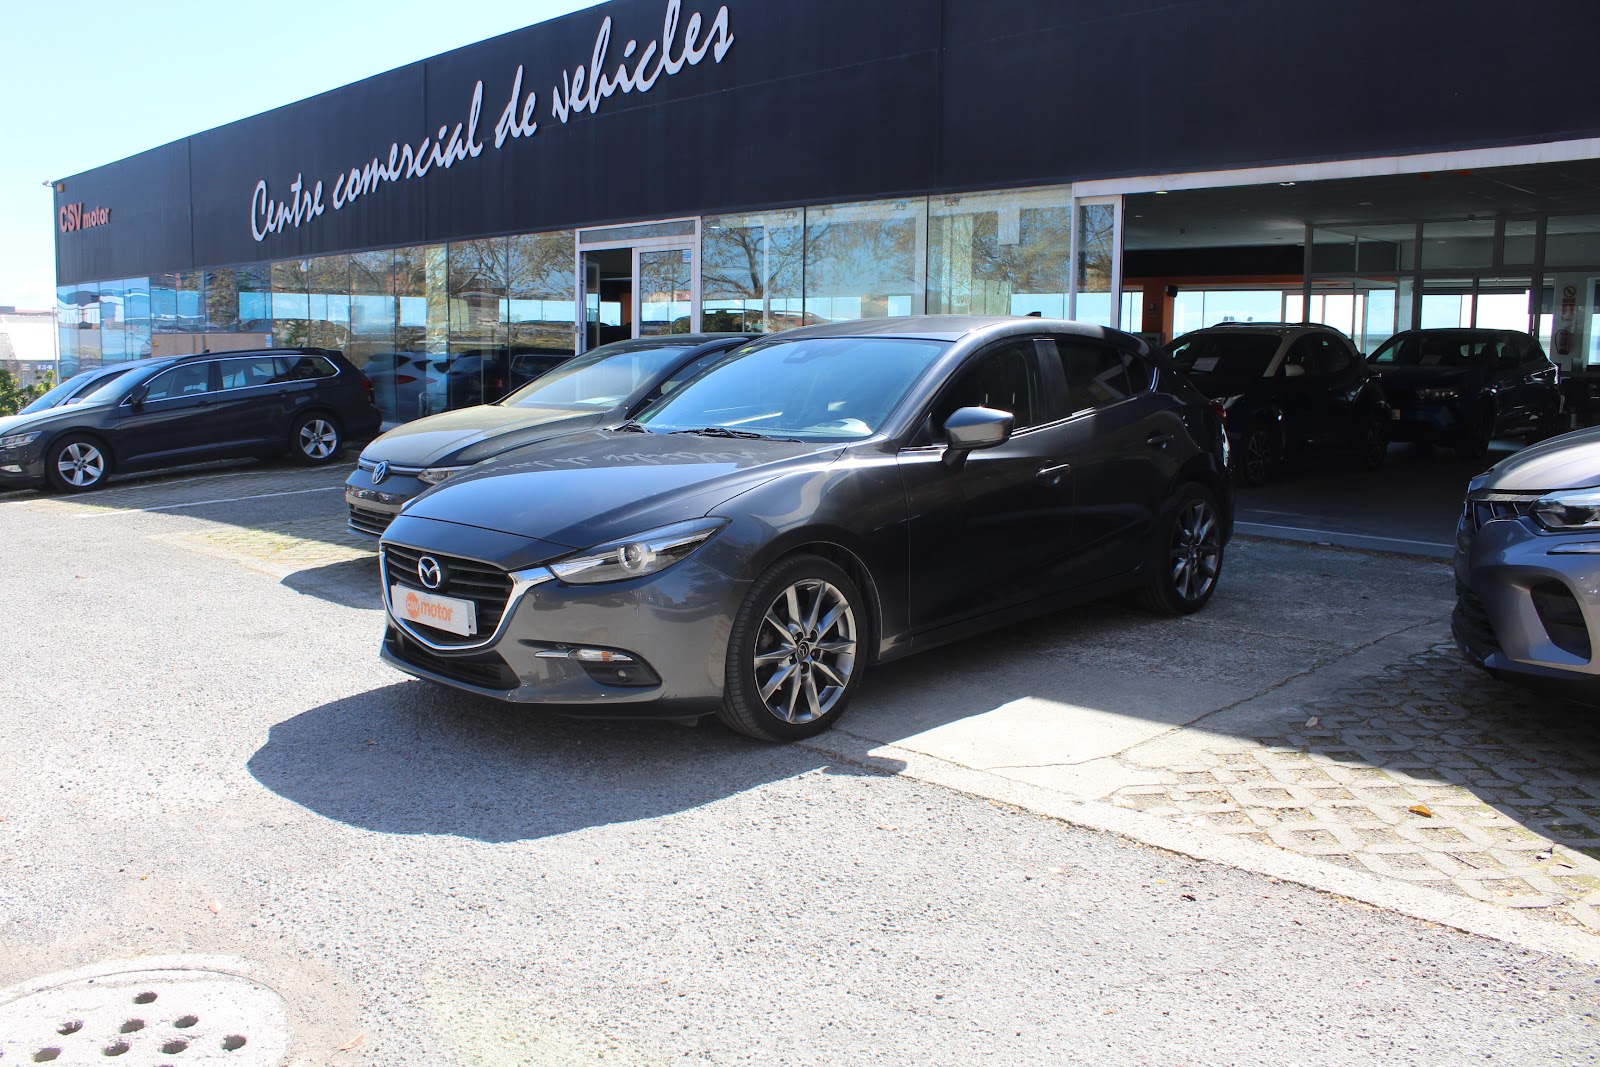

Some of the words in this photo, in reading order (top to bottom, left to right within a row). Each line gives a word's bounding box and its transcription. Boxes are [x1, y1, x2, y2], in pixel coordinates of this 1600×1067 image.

[251, 172, 325, 242] Centre
[333, 80, 483, 210] comercial
[495, 64, 537, 149] de
[552, 0, 734, 124] vehicles
[60, 202, 82, 232] CSV
[82, 205, 109, 229] motor
[420, 601, 453, 622] motor
